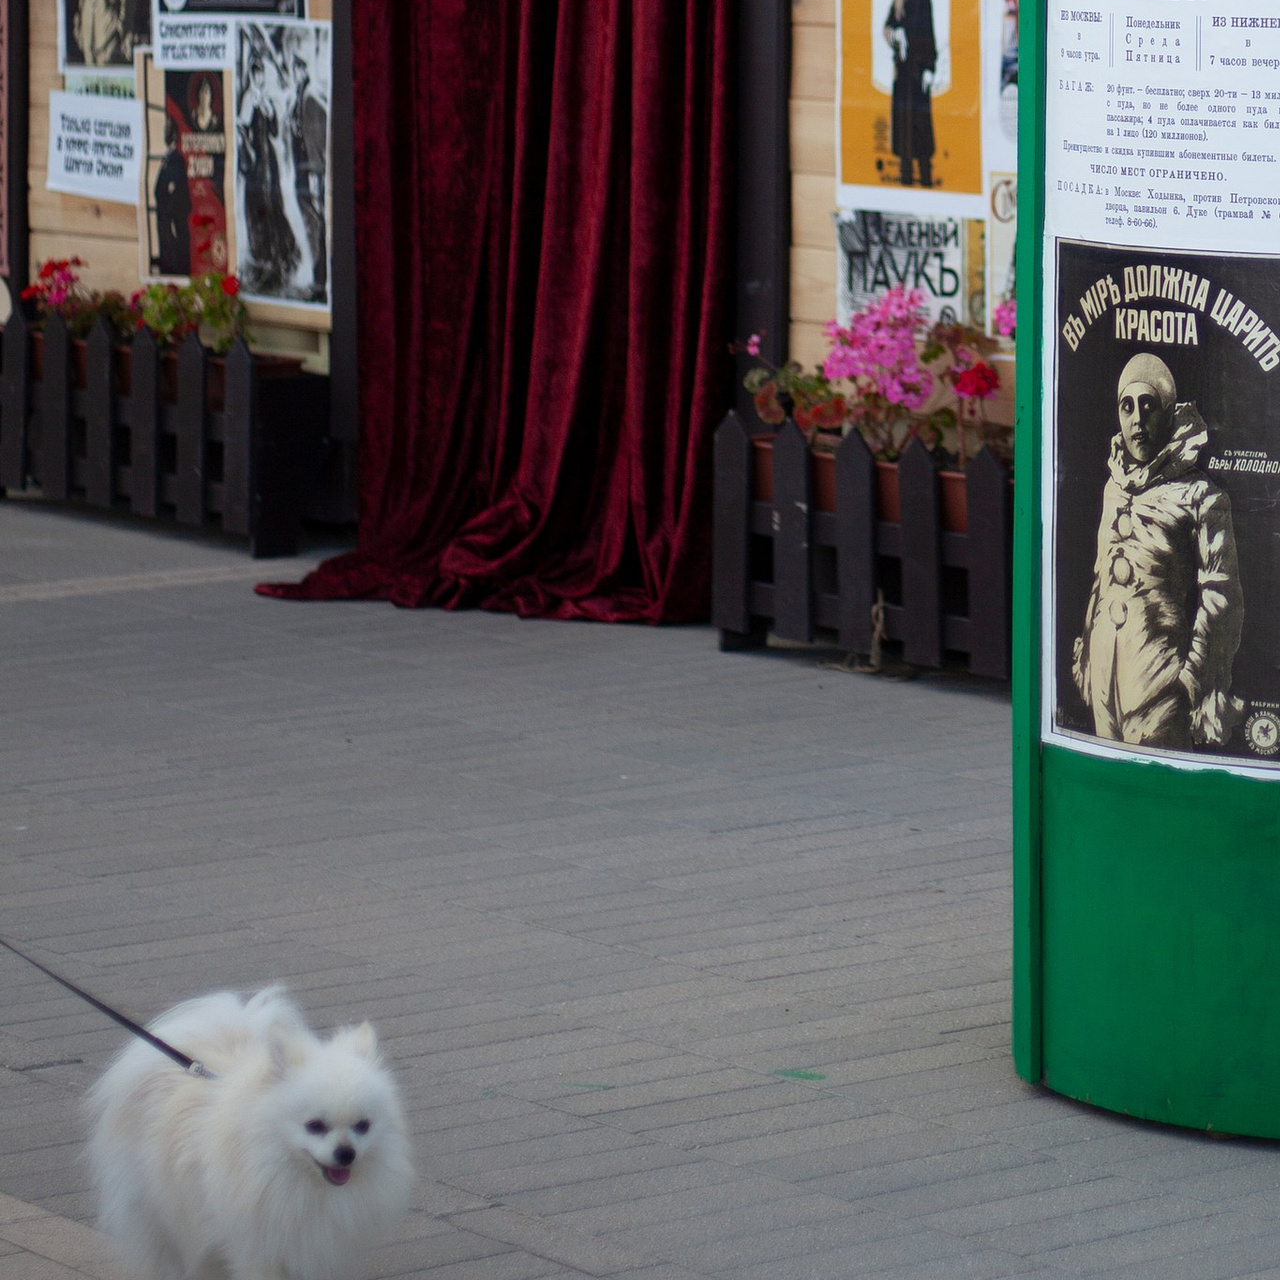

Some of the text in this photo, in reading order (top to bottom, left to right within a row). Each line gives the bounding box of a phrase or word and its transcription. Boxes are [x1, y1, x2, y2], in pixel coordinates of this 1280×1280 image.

[1061, 10, 1069, 20] ИЗ
[1212, 16, 1227, 28] ИЗ
[1126, 16, 1181, 30] Понедельник
[1245, 39, 1251, 48] в
[1210, 55, 1215, 65] 7
[1220, 57, 1247, 67] часов
[1107, 84, 1115, 92] 20
[1188, 90, 1210, 99] сверх
[1252, 90, 1261, 99] 13
[1090, 164, 1227, 181] ЧИСЛО МЕСТ ОГРАНИЧЕНО.
[1062, 314, 1086, 352] ВЪ
[1124, 264, 1211, 312] ДОЛЖНА
[1115, 307, 1198, 346] КРАСОТА
